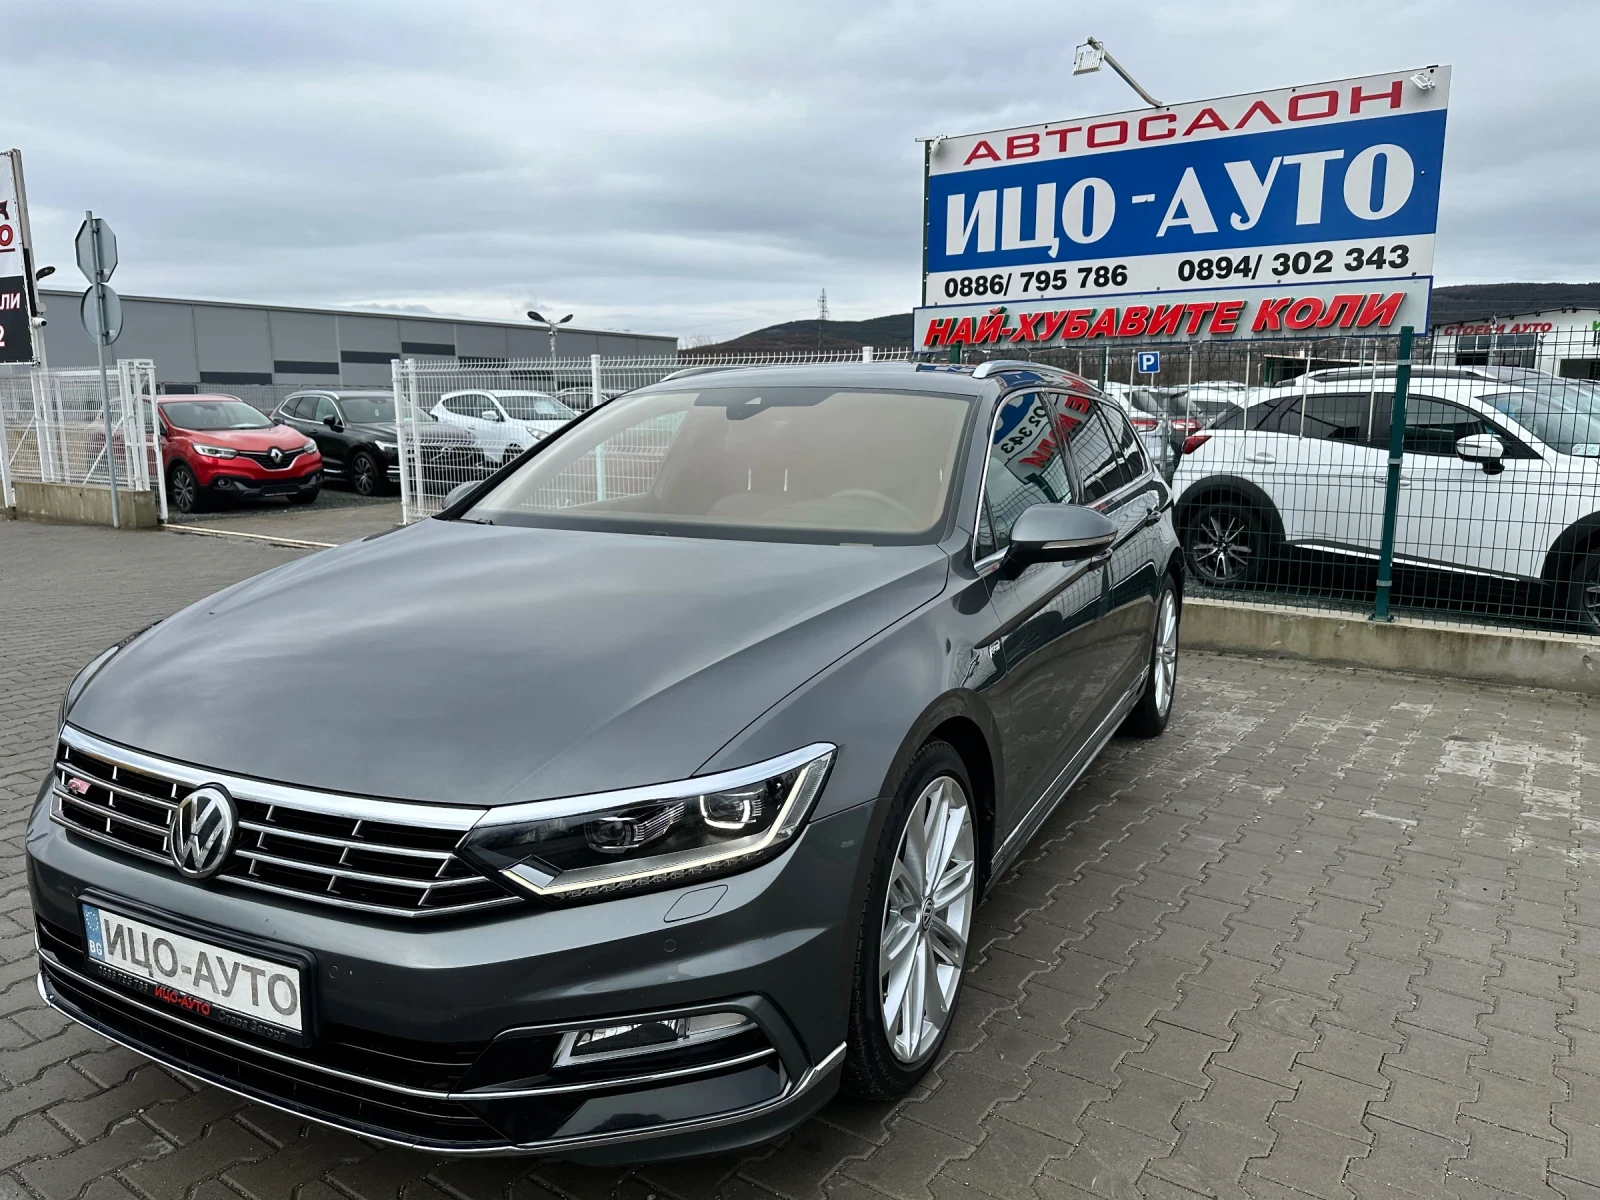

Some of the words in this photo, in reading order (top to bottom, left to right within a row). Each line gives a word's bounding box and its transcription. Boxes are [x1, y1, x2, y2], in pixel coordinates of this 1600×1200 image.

[963, 81, 1404, 166] АВТОСАЛОН
[1177, 254, 1263, 282] 0894/
[1271, 250, 1333, 276] 302
[1344, 244, 1409, 271] 343
[944, 273, 1012, 298] 0886/
[1020, 269, 1067, 293] 795
[1077, 264, 1128, 289] 786
[923, 300, 1246, 347] НАЙ-ХУБАВИТЕ
[1251, 291, 1407, 332] КОЛИ
[1510, 322, 1552, 334] АУТО
[1143, 355, 1154, 367] P
[89, 939, 103, 956] BG
[104, 918, 298, 1016] ИЦО-АУТО
[154, 985, 212, 1016] ИЦО-АУТО
[218, 1010, 248, 1029] Стара
[250, 1020, 287, 1042] Загора
